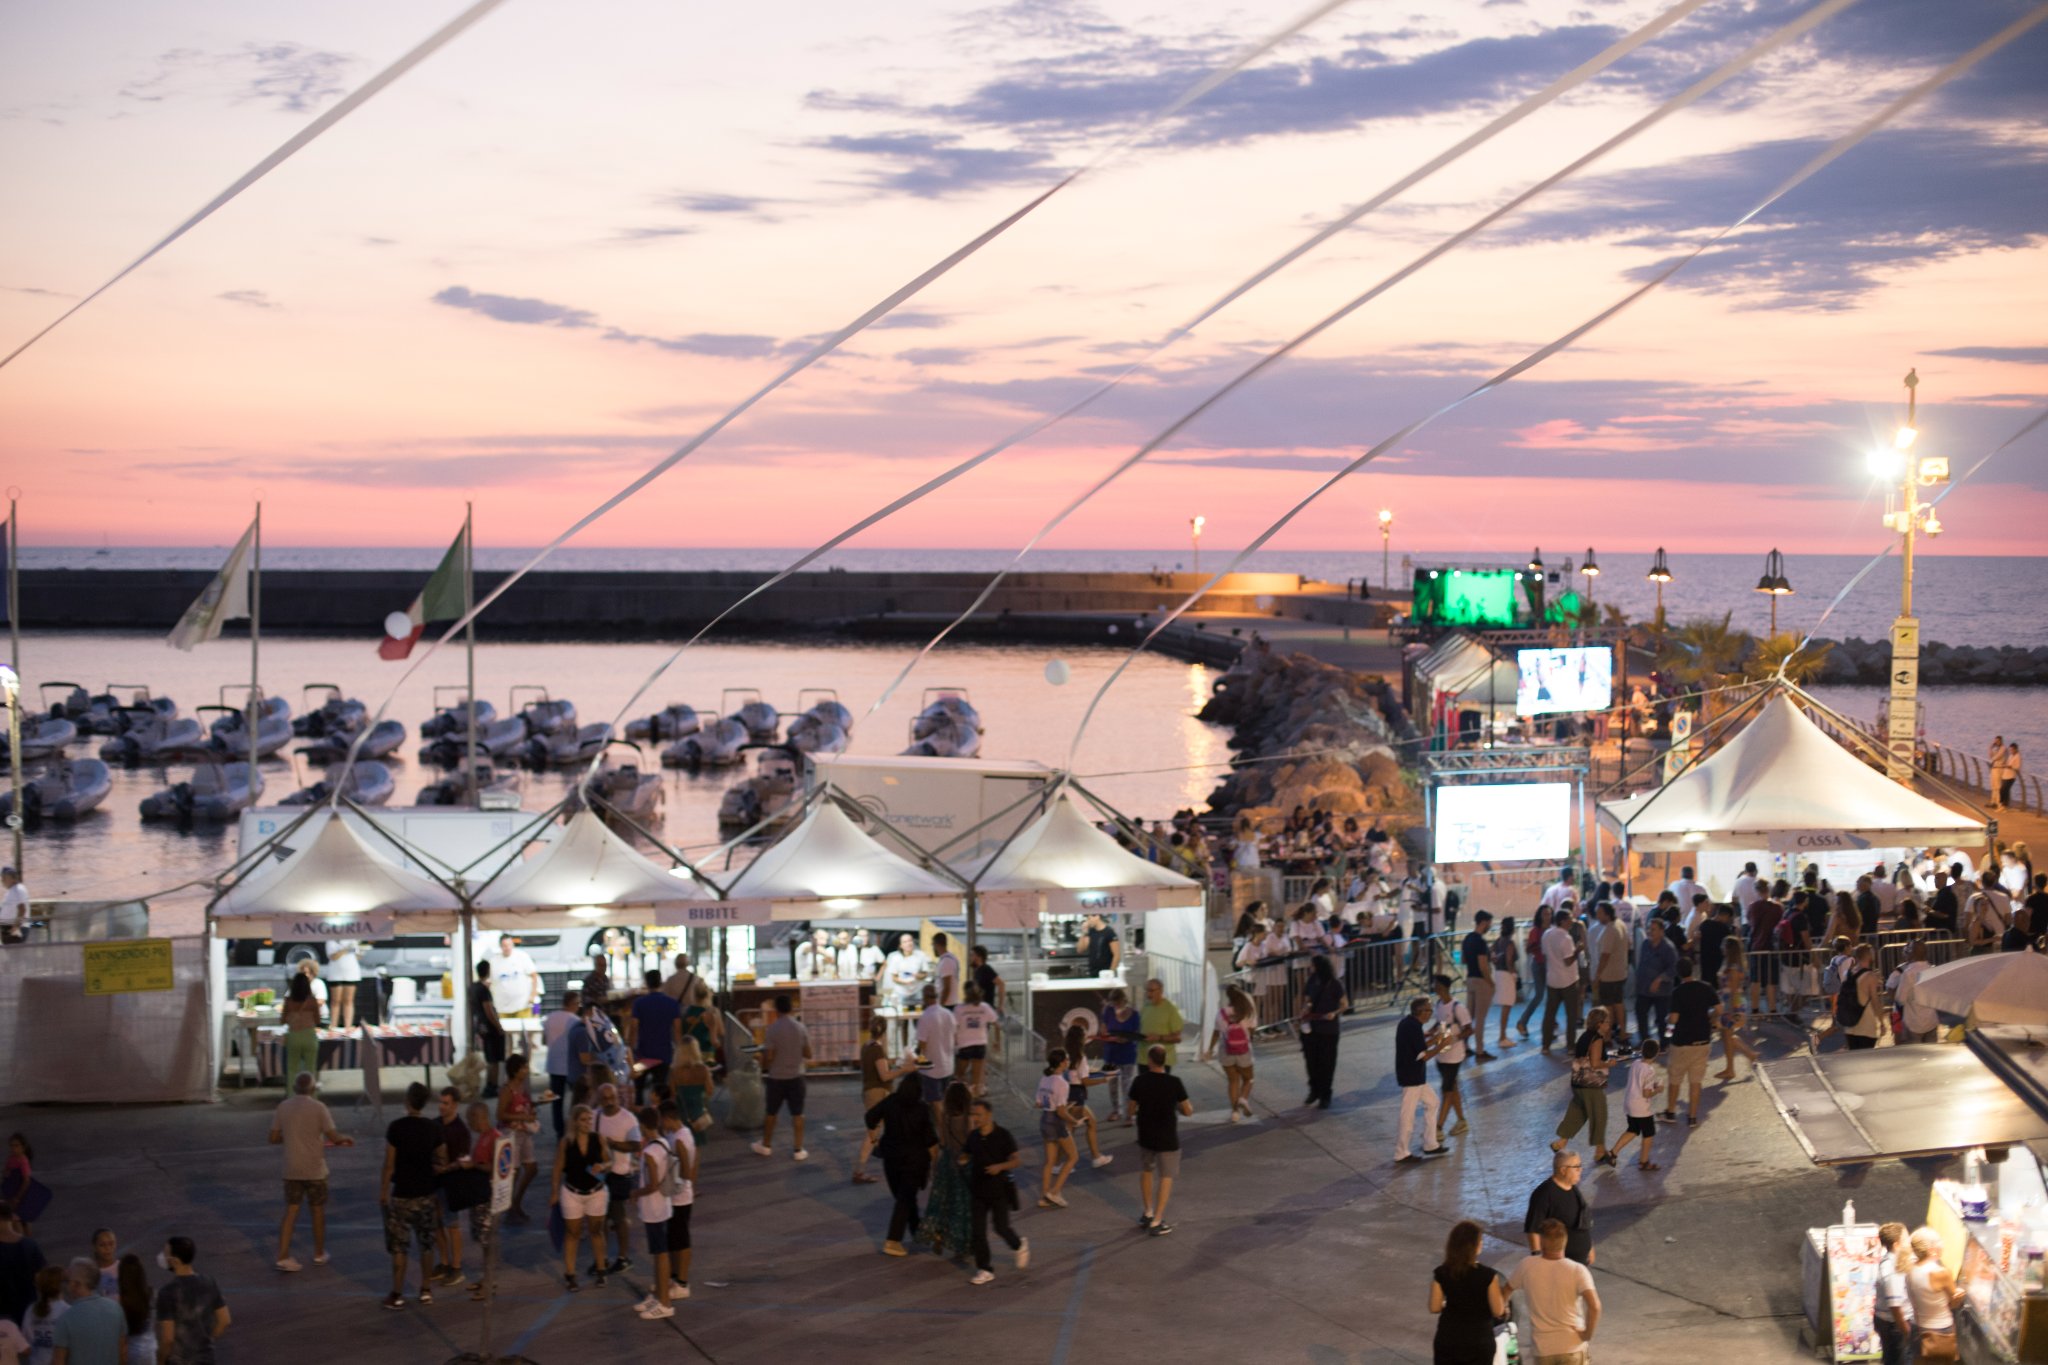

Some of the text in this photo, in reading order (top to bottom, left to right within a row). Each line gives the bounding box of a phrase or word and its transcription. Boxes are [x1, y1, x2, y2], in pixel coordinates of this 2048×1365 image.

[1797, 835, 1842, 847] CASSA
[1081, 892, 1126, 909] CAFFÈ
[688, 907, 740, 920] BIBITE
[291, 921, 374, 935] ANGURIA
